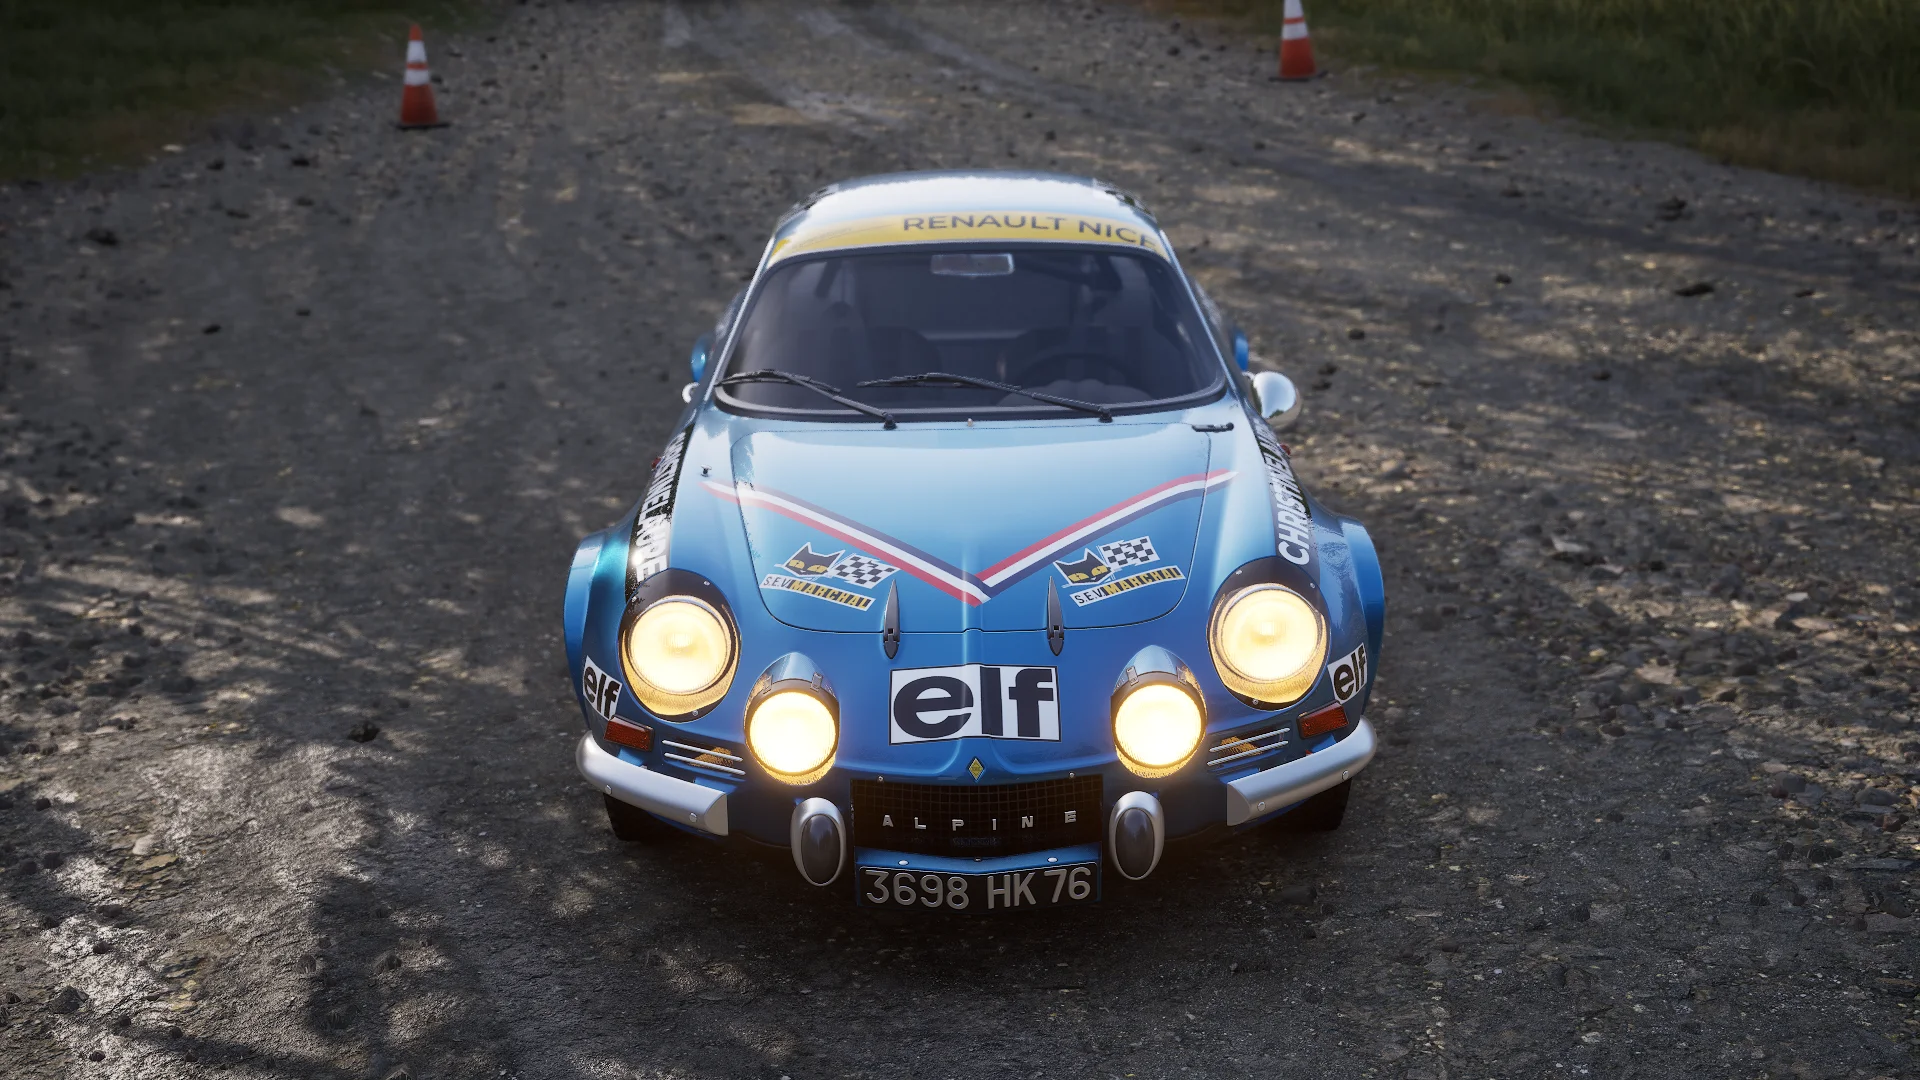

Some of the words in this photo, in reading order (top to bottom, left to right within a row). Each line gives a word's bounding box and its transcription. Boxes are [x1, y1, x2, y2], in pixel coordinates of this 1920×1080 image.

[903, 214, 1067, 232] RENAULT
[583, 666, 619, 720] elf
[1333, 644, 1366, 700] elf
[893, 666, 1054, 738] elf
[882, 810, 1077, 832] ALPINE
[865, 869, 970, 910] 3698
[987, 872, 1036, 909] HK
[1044, 867, 1092, 903] 76
